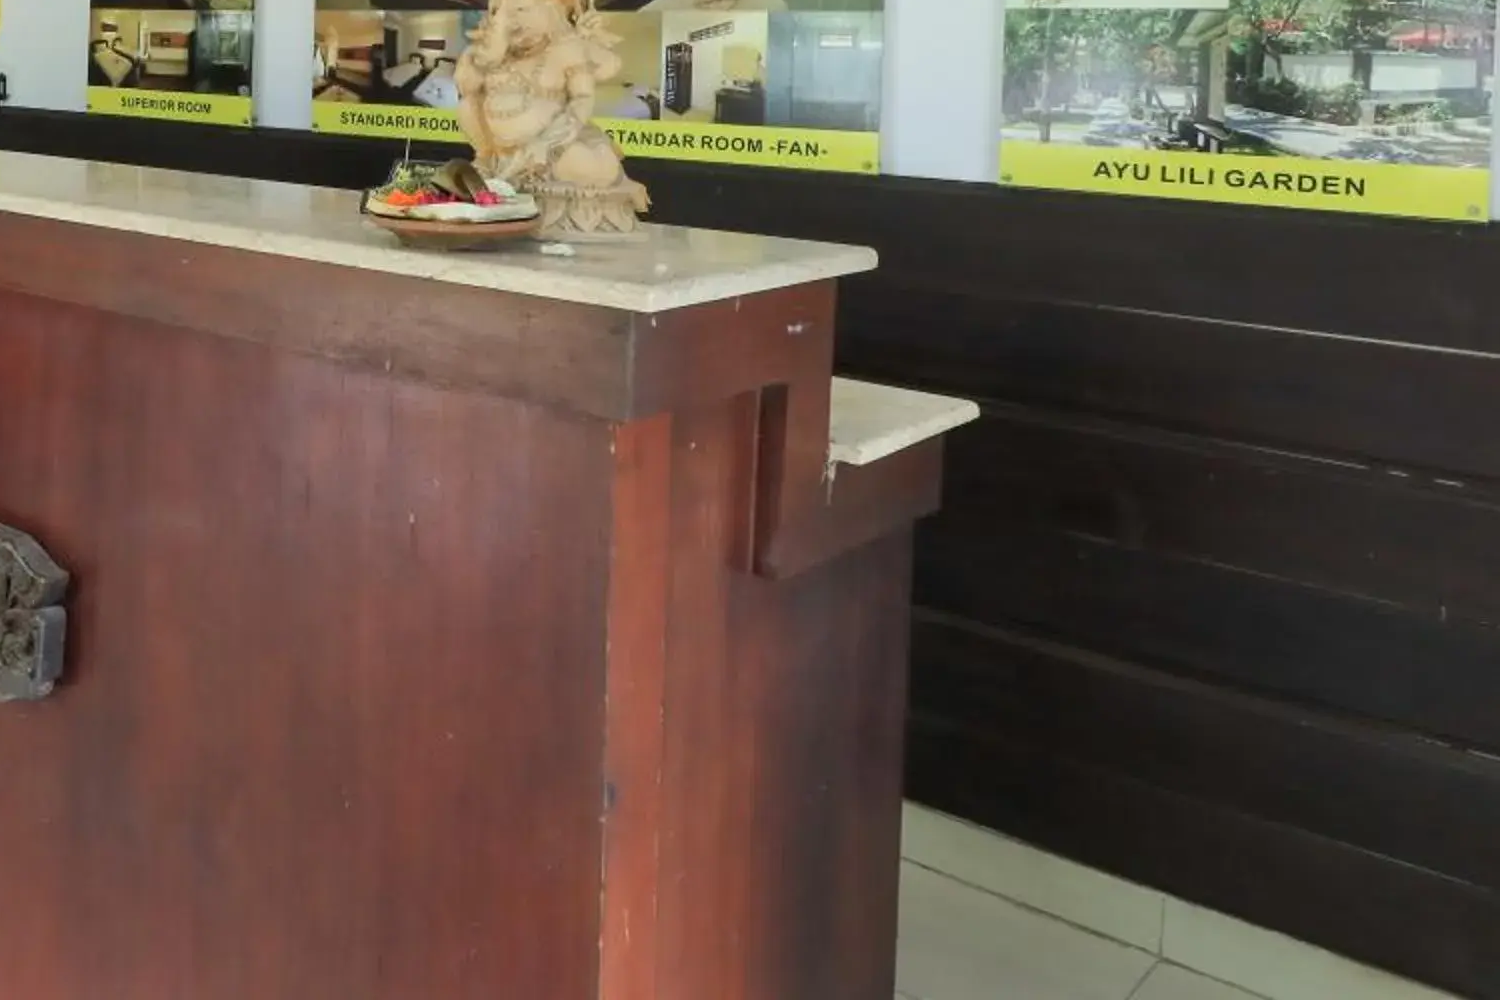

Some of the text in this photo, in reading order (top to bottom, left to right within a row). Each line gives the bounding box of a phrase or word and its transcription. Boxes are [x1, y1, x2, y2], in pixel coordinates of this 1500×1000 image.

[120, 96, 212, 113] SUPERIOR ROOM
[340, 111, 415, 129] STANDARD
[700, 135, 763, 153] ROOM
[1093, 160, 1366, 197] AYU LILI GARDEN
